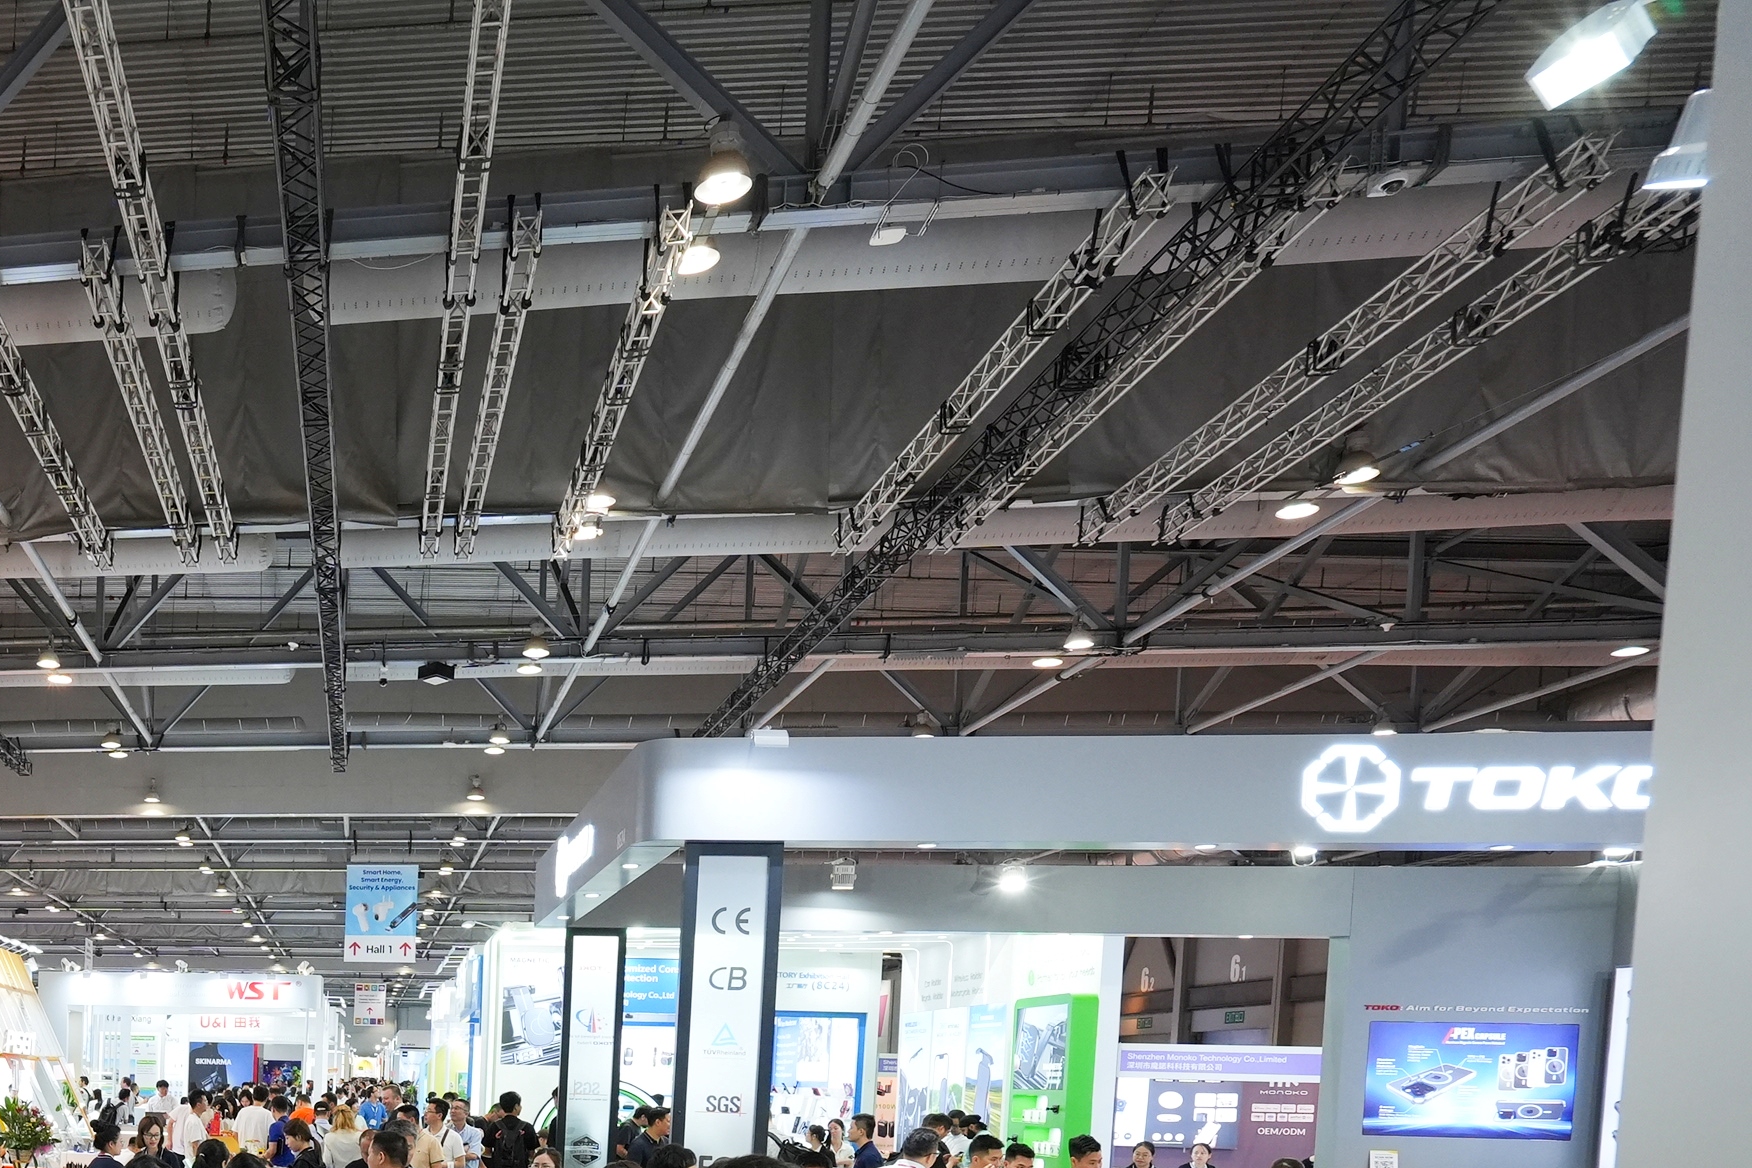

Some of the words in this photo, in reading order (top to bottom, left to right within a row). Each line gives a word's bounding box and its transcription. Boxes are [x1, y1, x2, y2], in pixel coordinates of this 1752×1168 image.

[712, 907, 751, 935] CE
[366, 945, 385, 954] Hall
[388, 945, 393, 954] 1
[776, 971, 797, 979] TORY
[1230, 954, 1247, 983] 6.1
[708, 967, 747, 991] CB
[1140, 967, 1155, 993] 6.2
[226, 981, 292, 1001] WST
[1405, 1004, 1431, 1012] Aim
[1433, 1004, 1453, 1012] for
[1455, 1005, 1505, 1014] Beyond
[1507, 1006, 1589, 1014] Expectation
[130, 1015, 152, 1025] Xiang
[200, 1015, 227, 1029] U&I
[234, 1016, 261, 1029] 由我
[195, 1057, 232, 1067] SKINARMA
[1127, 1052, 1166, 1061] Shenzhen
[1167, 1053, 1198, 1062] Monoko
[1199, 1054, 1241, 1064] Technology
[705, 1095, 741, 1114] SGS
[1257, 1127, 1306, 1136] OEM/ODM
